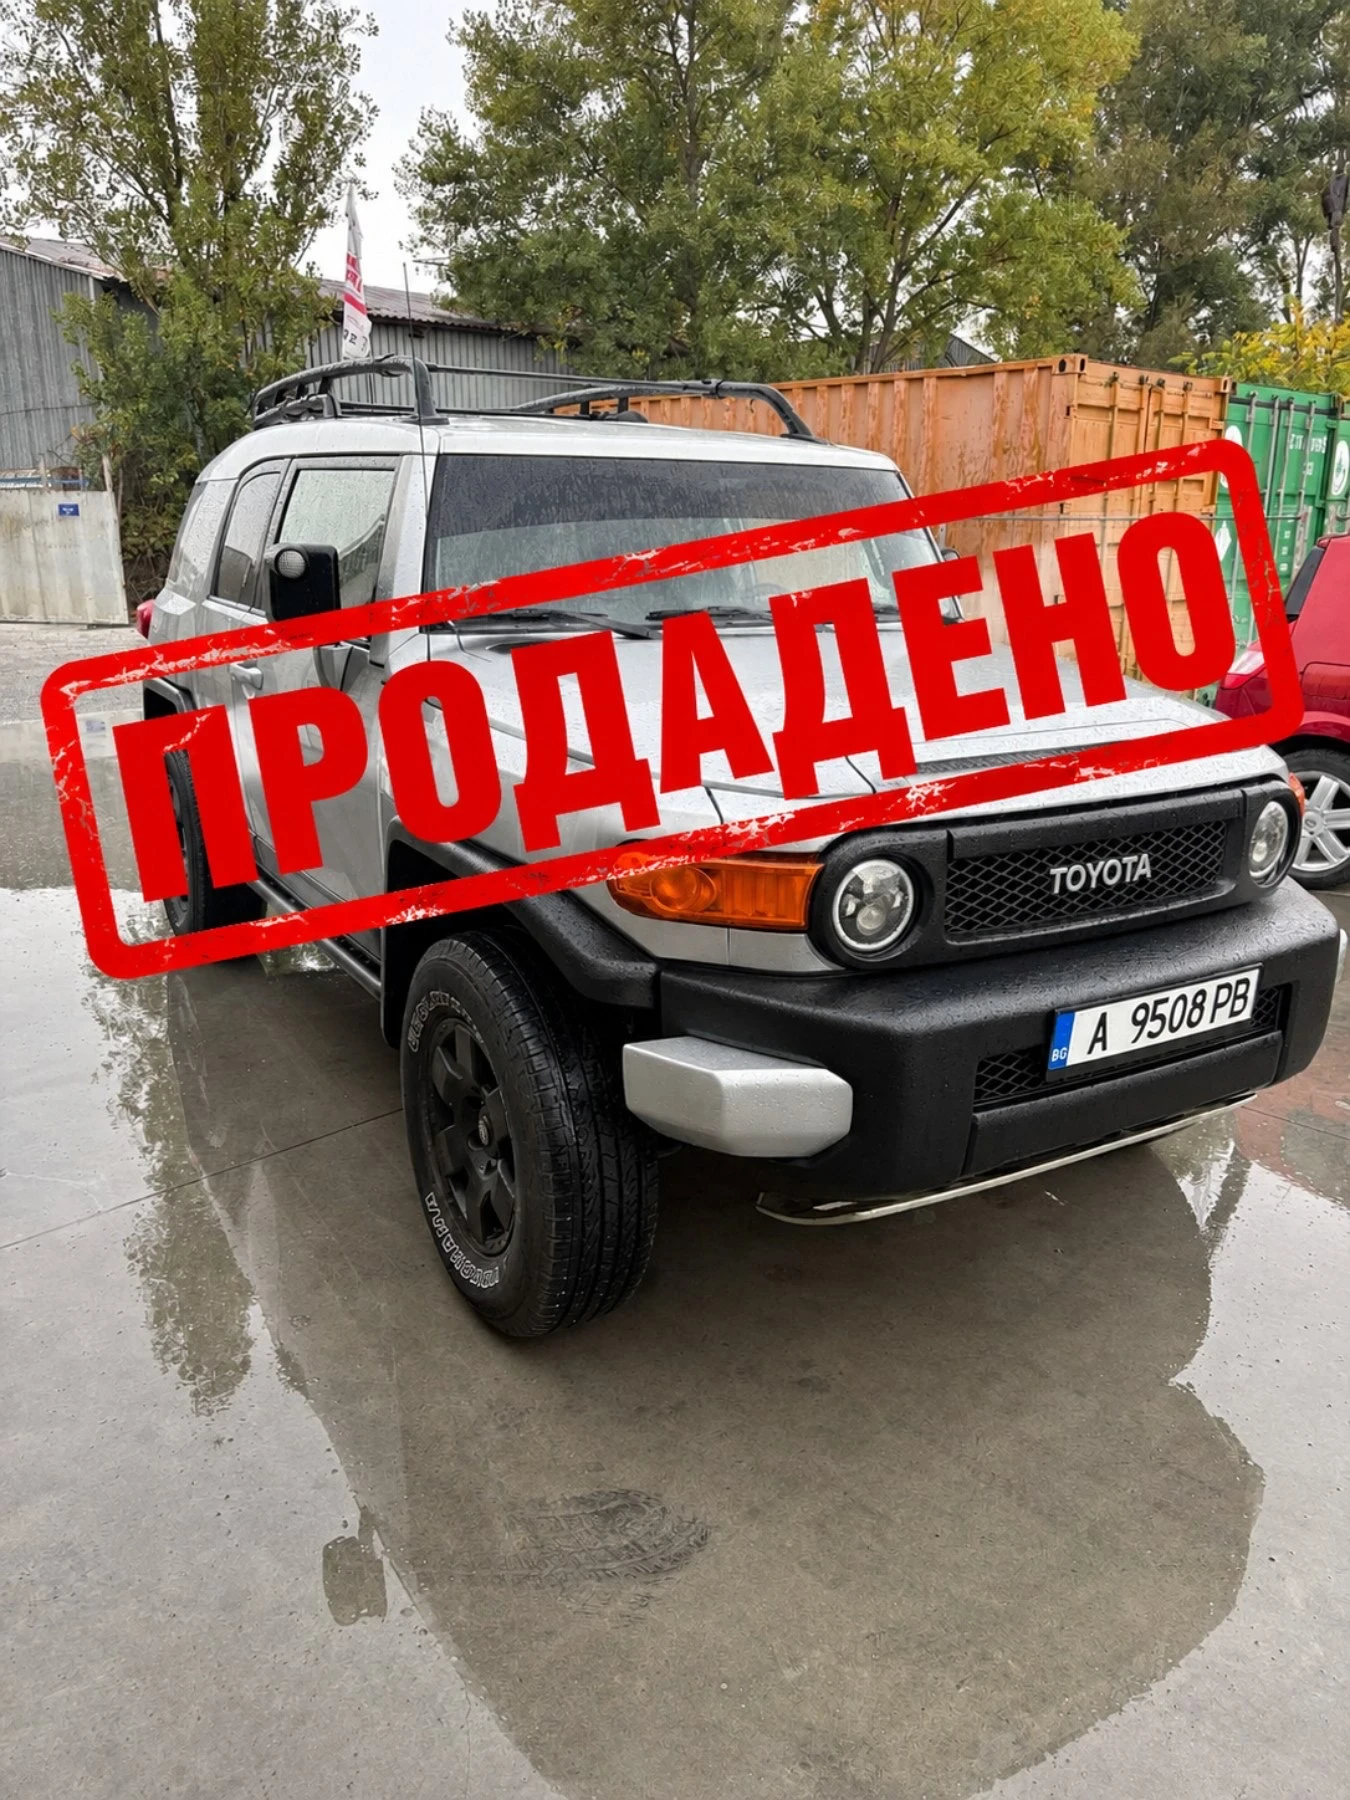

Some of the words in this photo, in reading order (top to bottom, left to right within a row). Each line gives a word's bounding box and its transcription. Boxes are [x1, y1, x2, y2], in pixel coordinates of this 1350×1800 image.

[1049, 853, 1152, 894] TOYOTA
[1087, 1011, 1108, 1055] A
[1131, 988, 1208, 1044] 9508
[1209, 977, 1251, 1024] PB
[1051, 1047, 1067, 1062] BG
